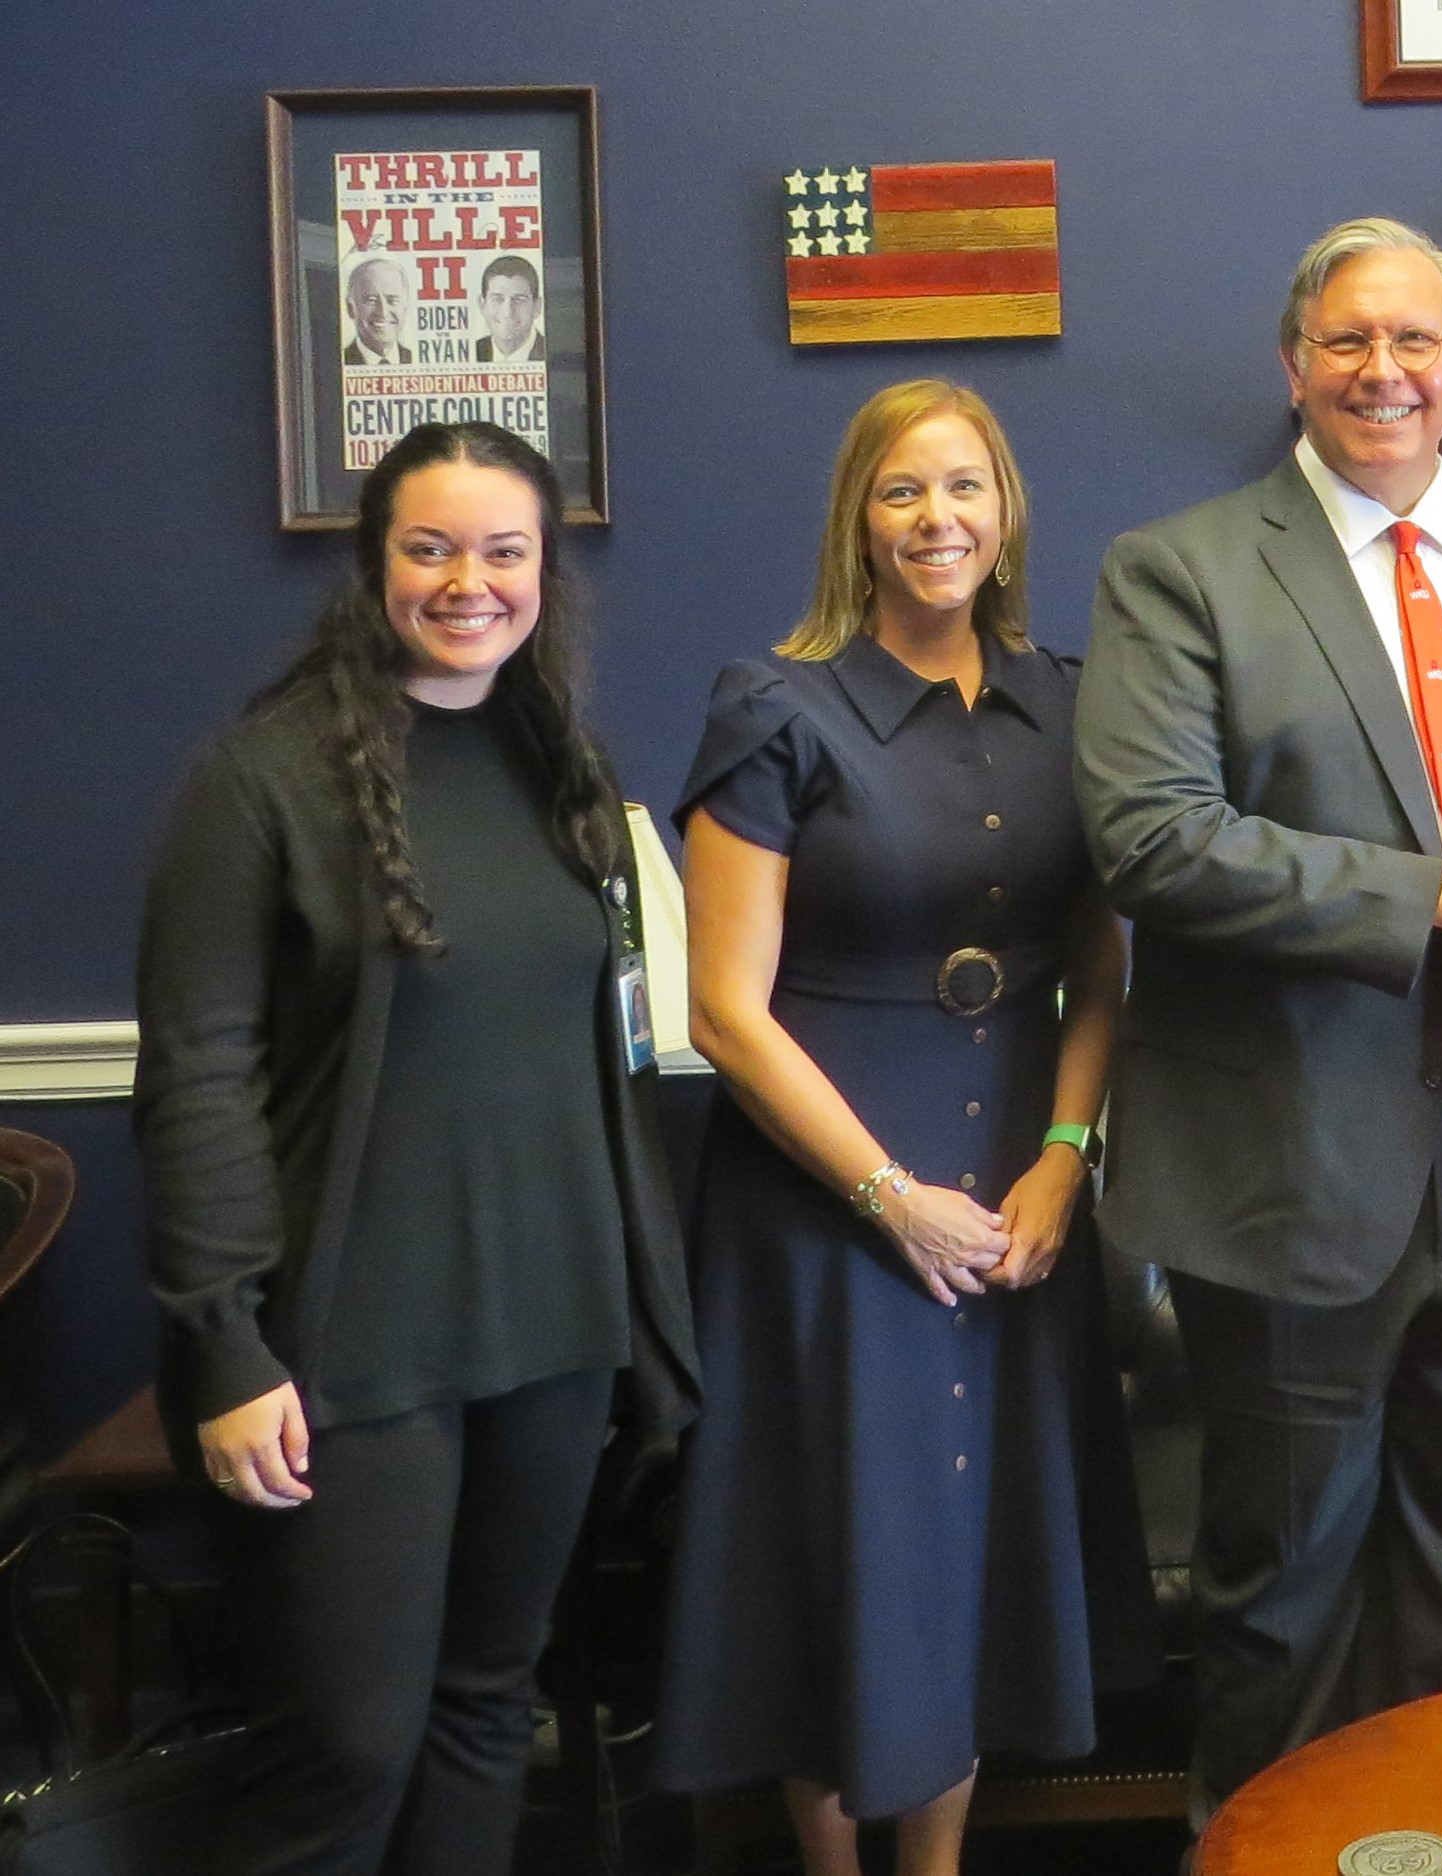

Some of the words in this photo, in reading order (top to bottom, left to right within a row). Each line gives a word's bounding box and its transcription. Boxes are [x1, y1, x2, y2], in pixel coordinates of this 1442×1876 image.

[339, 153, 538, 190] THRILL
[384, 193, 419, 204] IN
[428, 192, 495, 204] THE
[341, 206, 541, 251] VILLE
[416, 257, 467, 300] II
[417, 306, 469, 331] BIDEN
[418, 339, 470, 364] RYAN
[347, 377, 380, 395] VICE
[383, 374, 486, 394] PRESIDENTIAL
[488, 373, 544, 392] DEBATE
